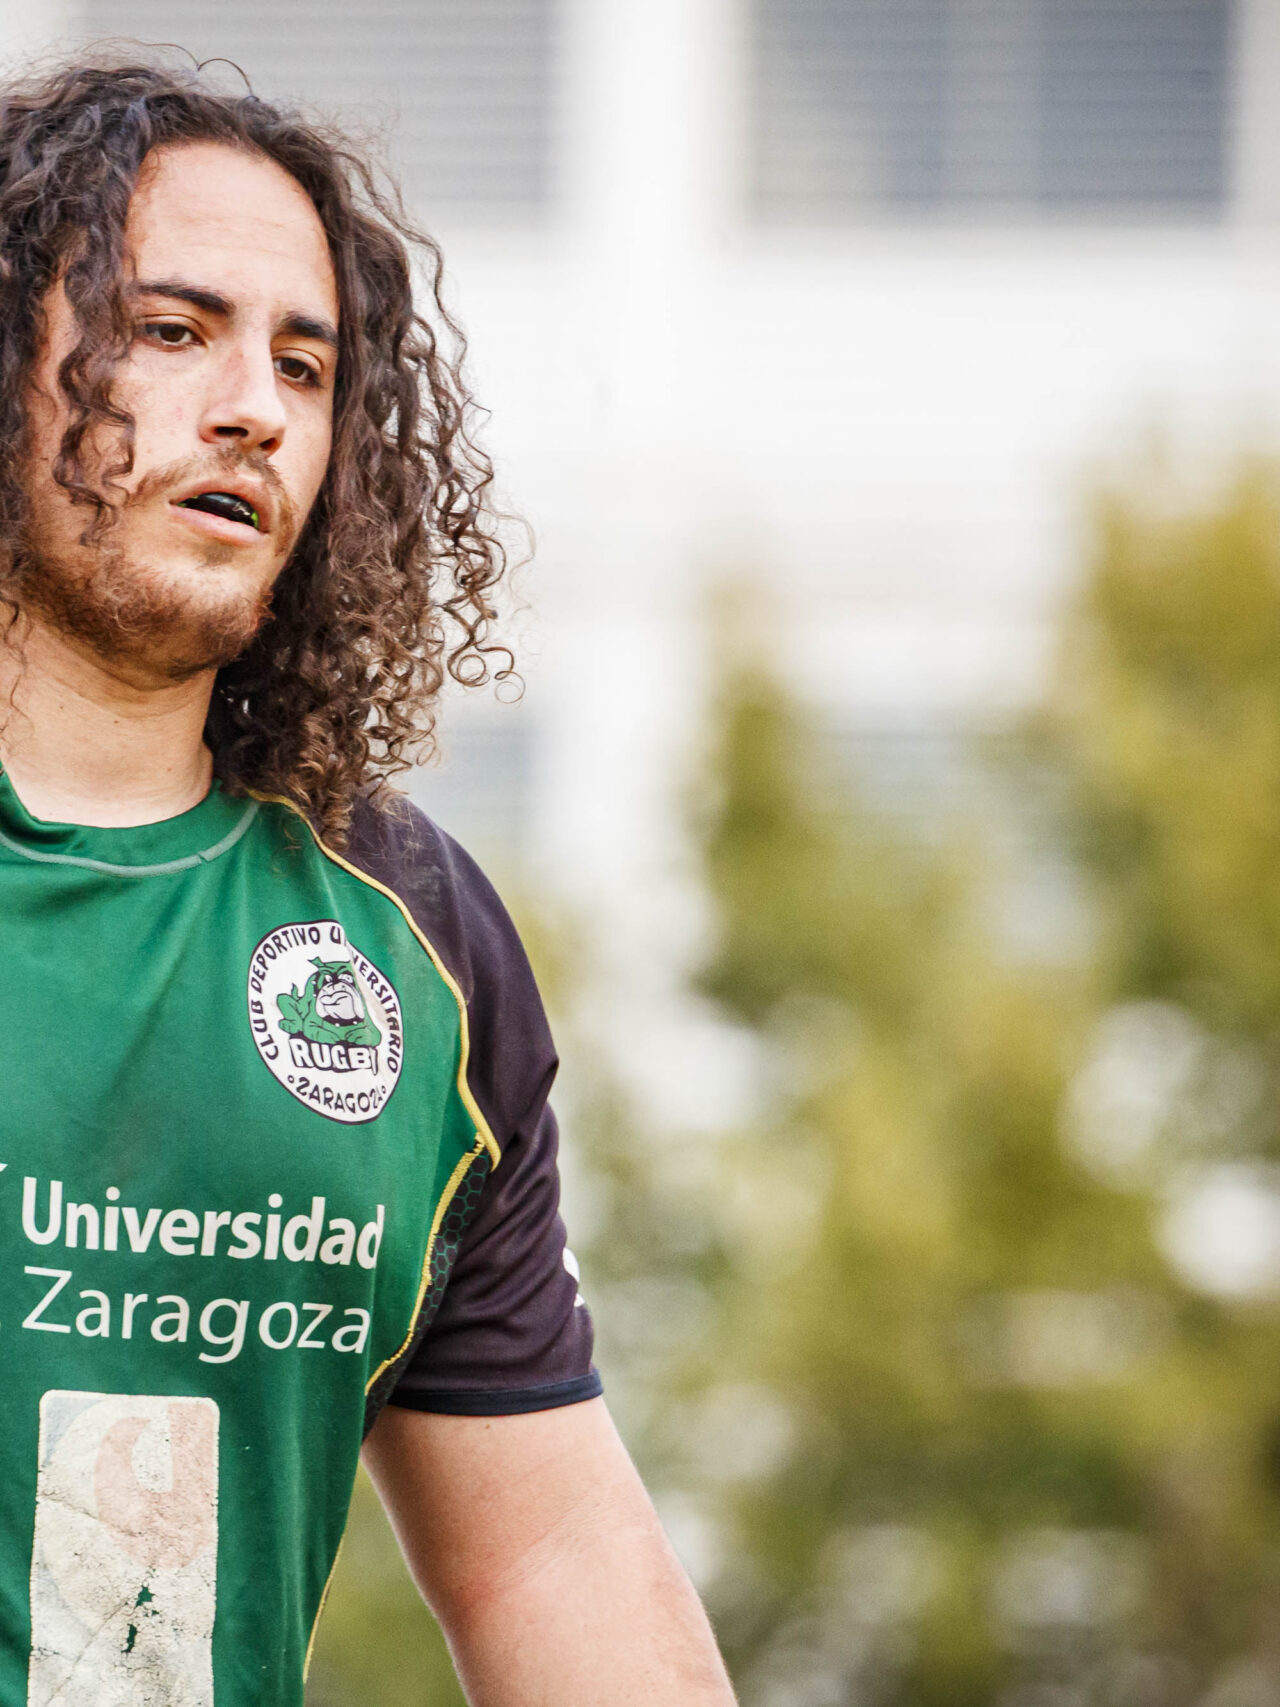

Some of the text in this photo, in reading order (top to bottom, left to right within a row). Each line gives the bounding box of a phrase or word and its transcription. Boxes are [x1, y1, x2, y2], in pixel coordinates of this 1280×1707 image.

[251, 926, 321, 994] DEPORTIVO
[251, 1000, 279, 1061] CLUB
[22, 1176, 385, 1270] Universidad
[22, 1265, 372, 1364] Zaragoza
